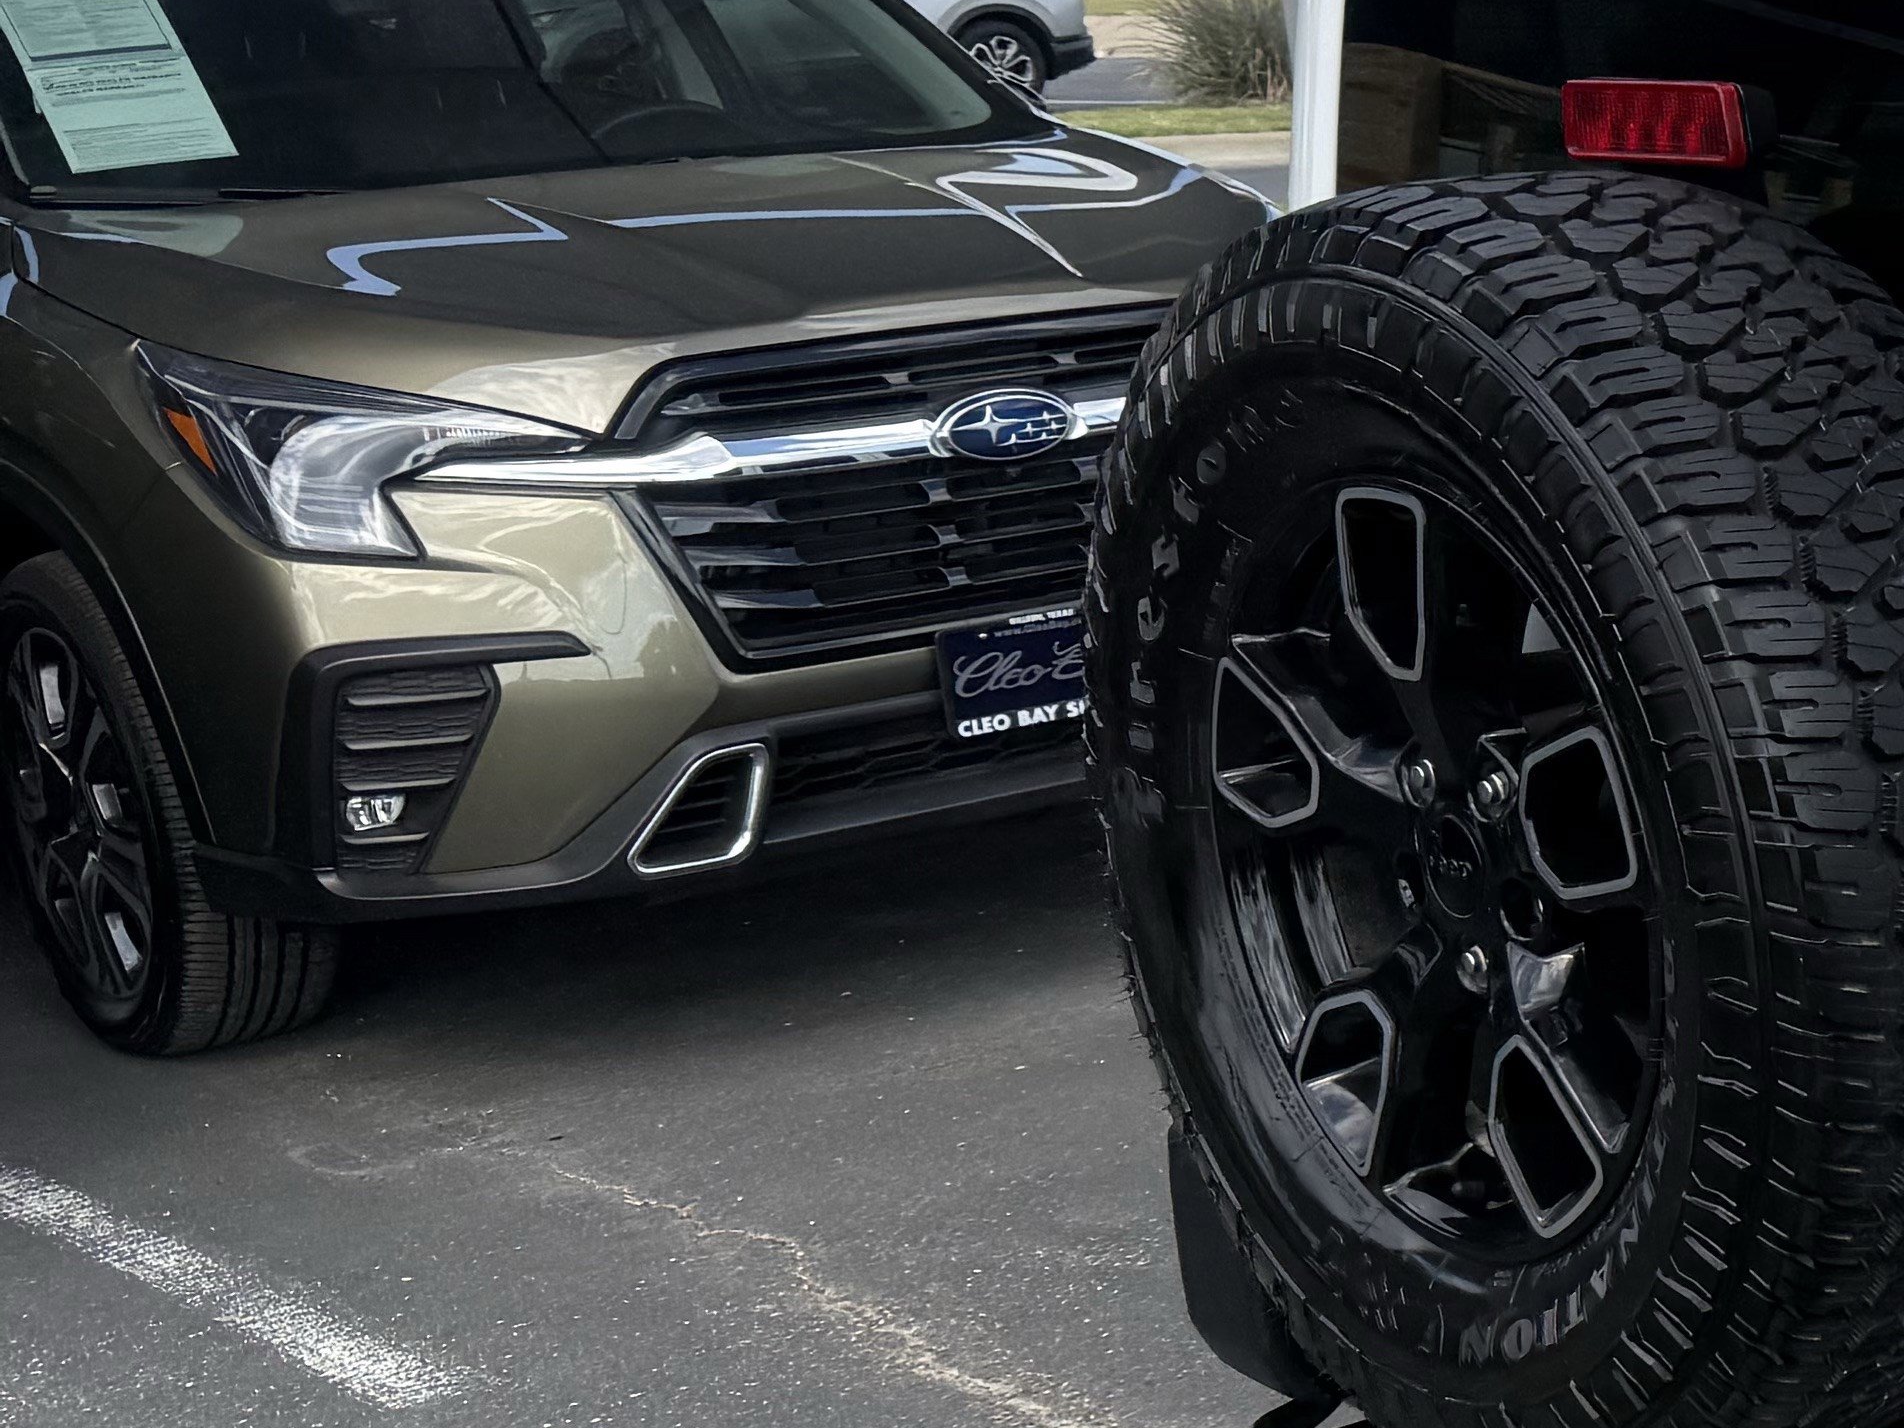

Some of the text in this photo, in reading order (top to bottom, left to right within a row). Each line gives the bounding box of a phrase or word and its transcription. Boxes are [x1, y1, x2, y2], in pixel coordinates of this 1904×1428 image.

[952, 650, 1052, 698] Cleo
[957, 713, 1011, 738] CLEO
[1017, 703, 1059, 727] BAY
